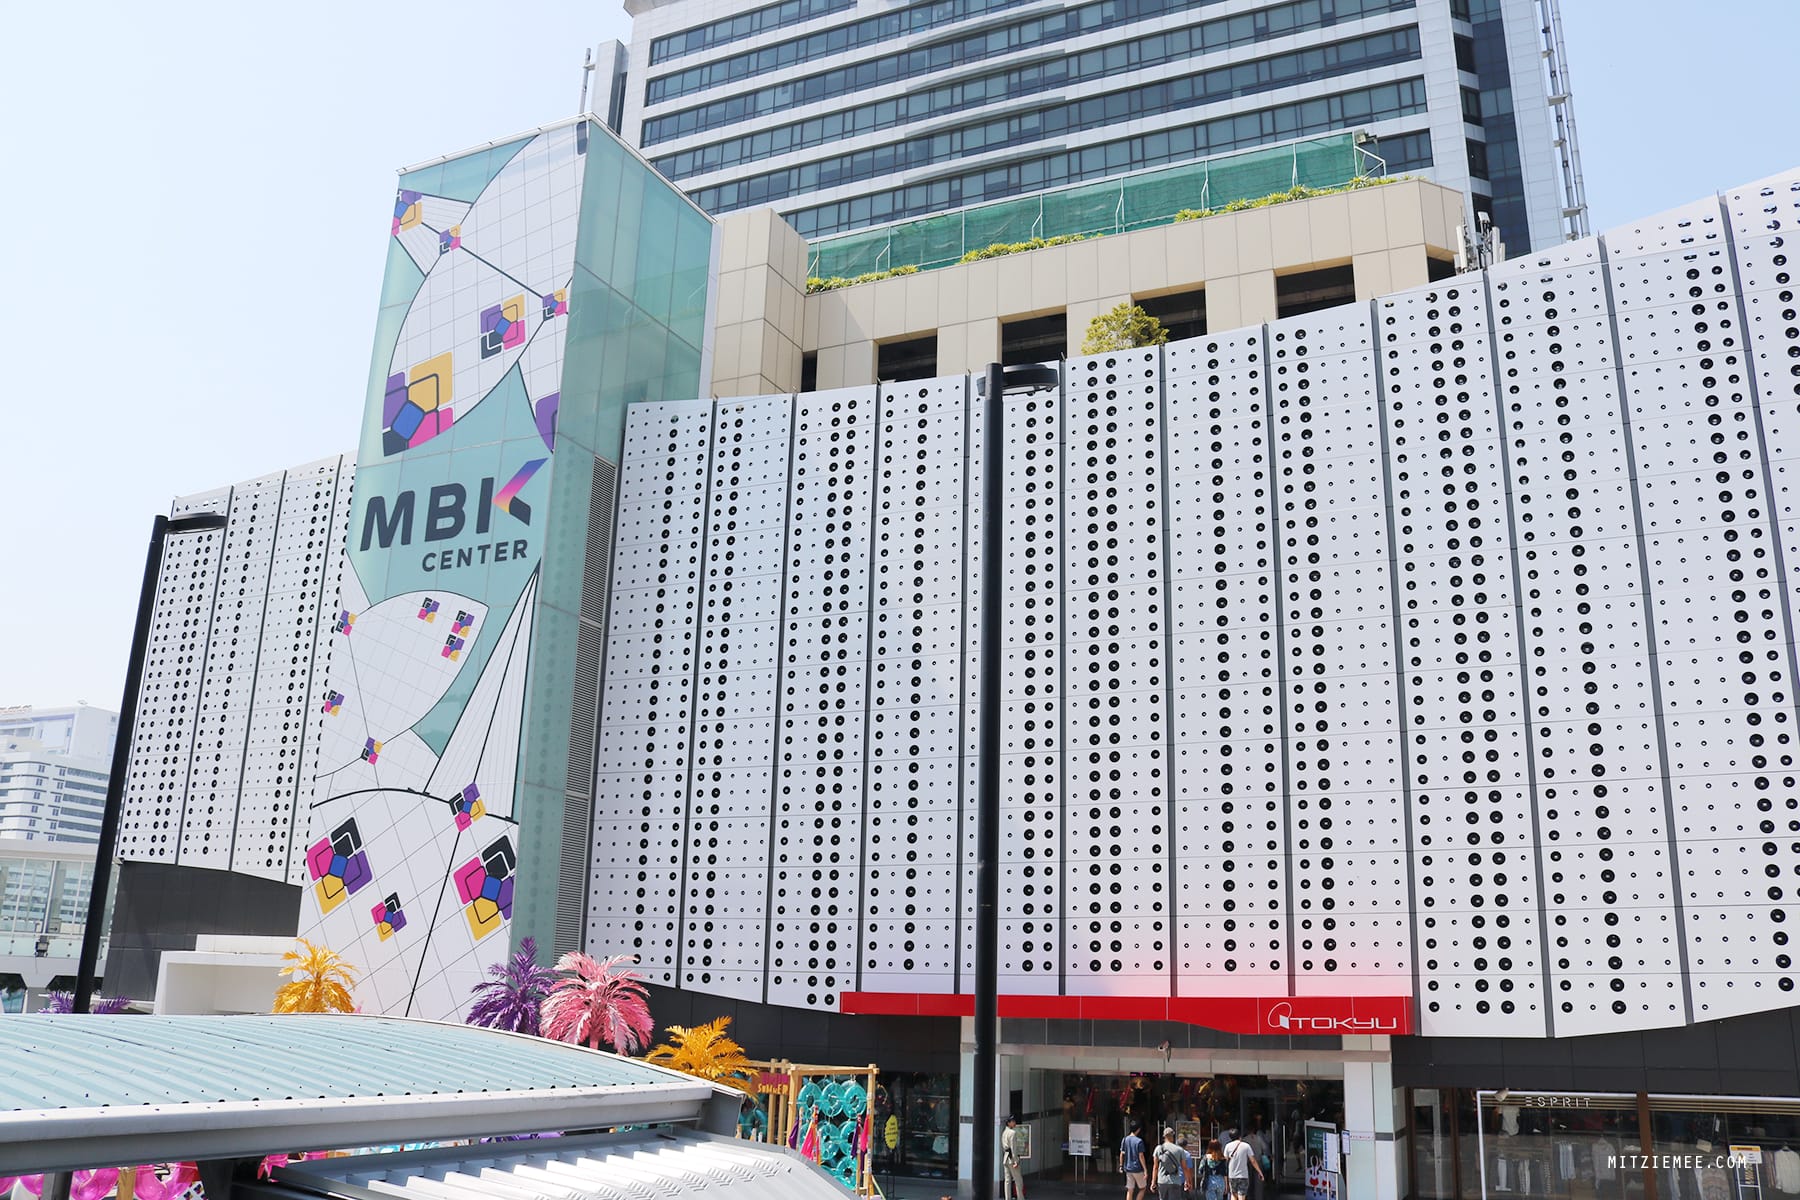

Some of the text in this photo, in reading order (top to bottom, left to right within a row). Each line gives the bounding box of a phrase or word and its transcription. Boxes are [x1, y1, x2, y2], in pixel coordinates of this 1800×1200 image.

[360, 457, 549, 552] MBK
[422, 539, 528, 573] CENTER
[1289, 1017, 1397, 1030] TOKYU
[1525, 1096, 1591, 1108] ESPRIT
